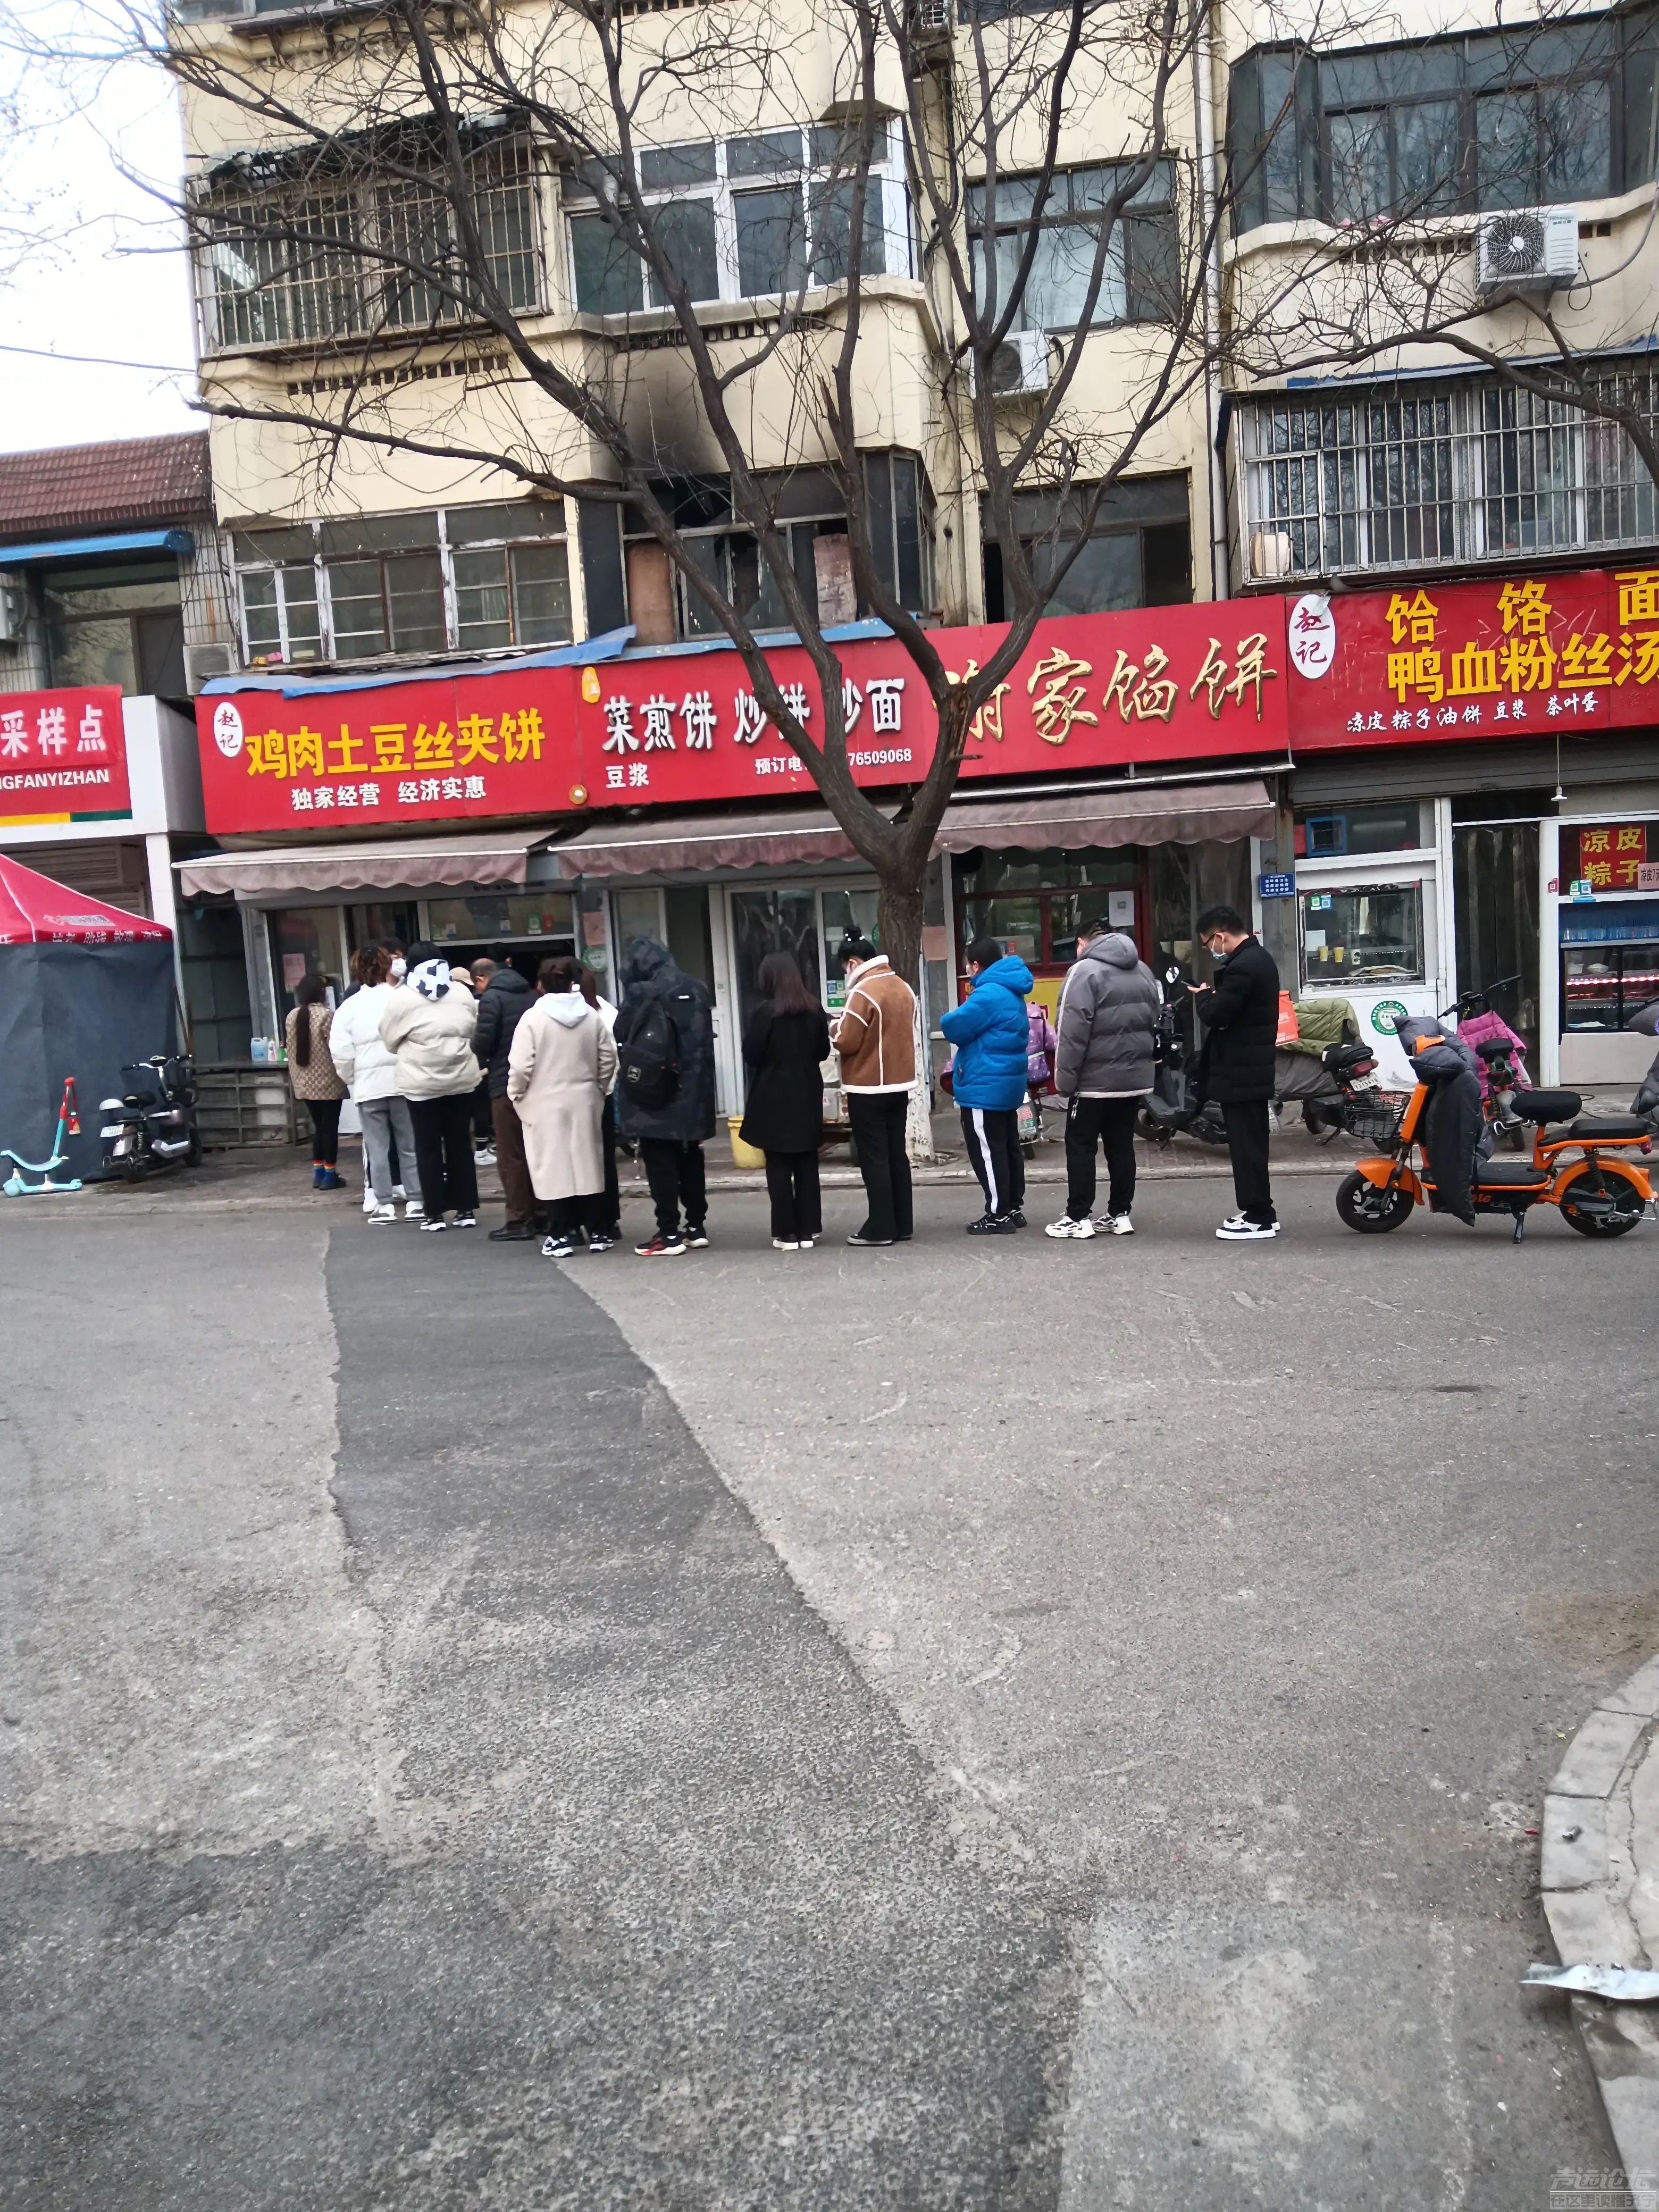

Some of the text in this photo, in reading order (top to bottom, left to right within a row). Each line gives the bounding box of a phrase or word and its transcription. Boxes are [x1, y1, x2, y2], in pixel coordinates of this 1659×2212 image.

[1387, 630, 1659, 703] 鸭血粉丝汤
[1, 704, 106, 758] 采样点
[217, 709, 239, 750] 赵记
[602, 690, 717, 755] 菜煎饼
[1347, 691, 1599, 732] 凉皮 粽子 油饼 豆浆 茶叶蛋
[245, 707, 546, 779] 鸡肉土豆丝夹饼
[605, 763, 650, 788] 豆浆
[755, 755, 808, 775] 预订电
[291, 775, 487, 810] 独家经营 经济实惠
[1583, 828, 1643, 853] 凉皮
[1583, 859, 1638, 886] 粽子
